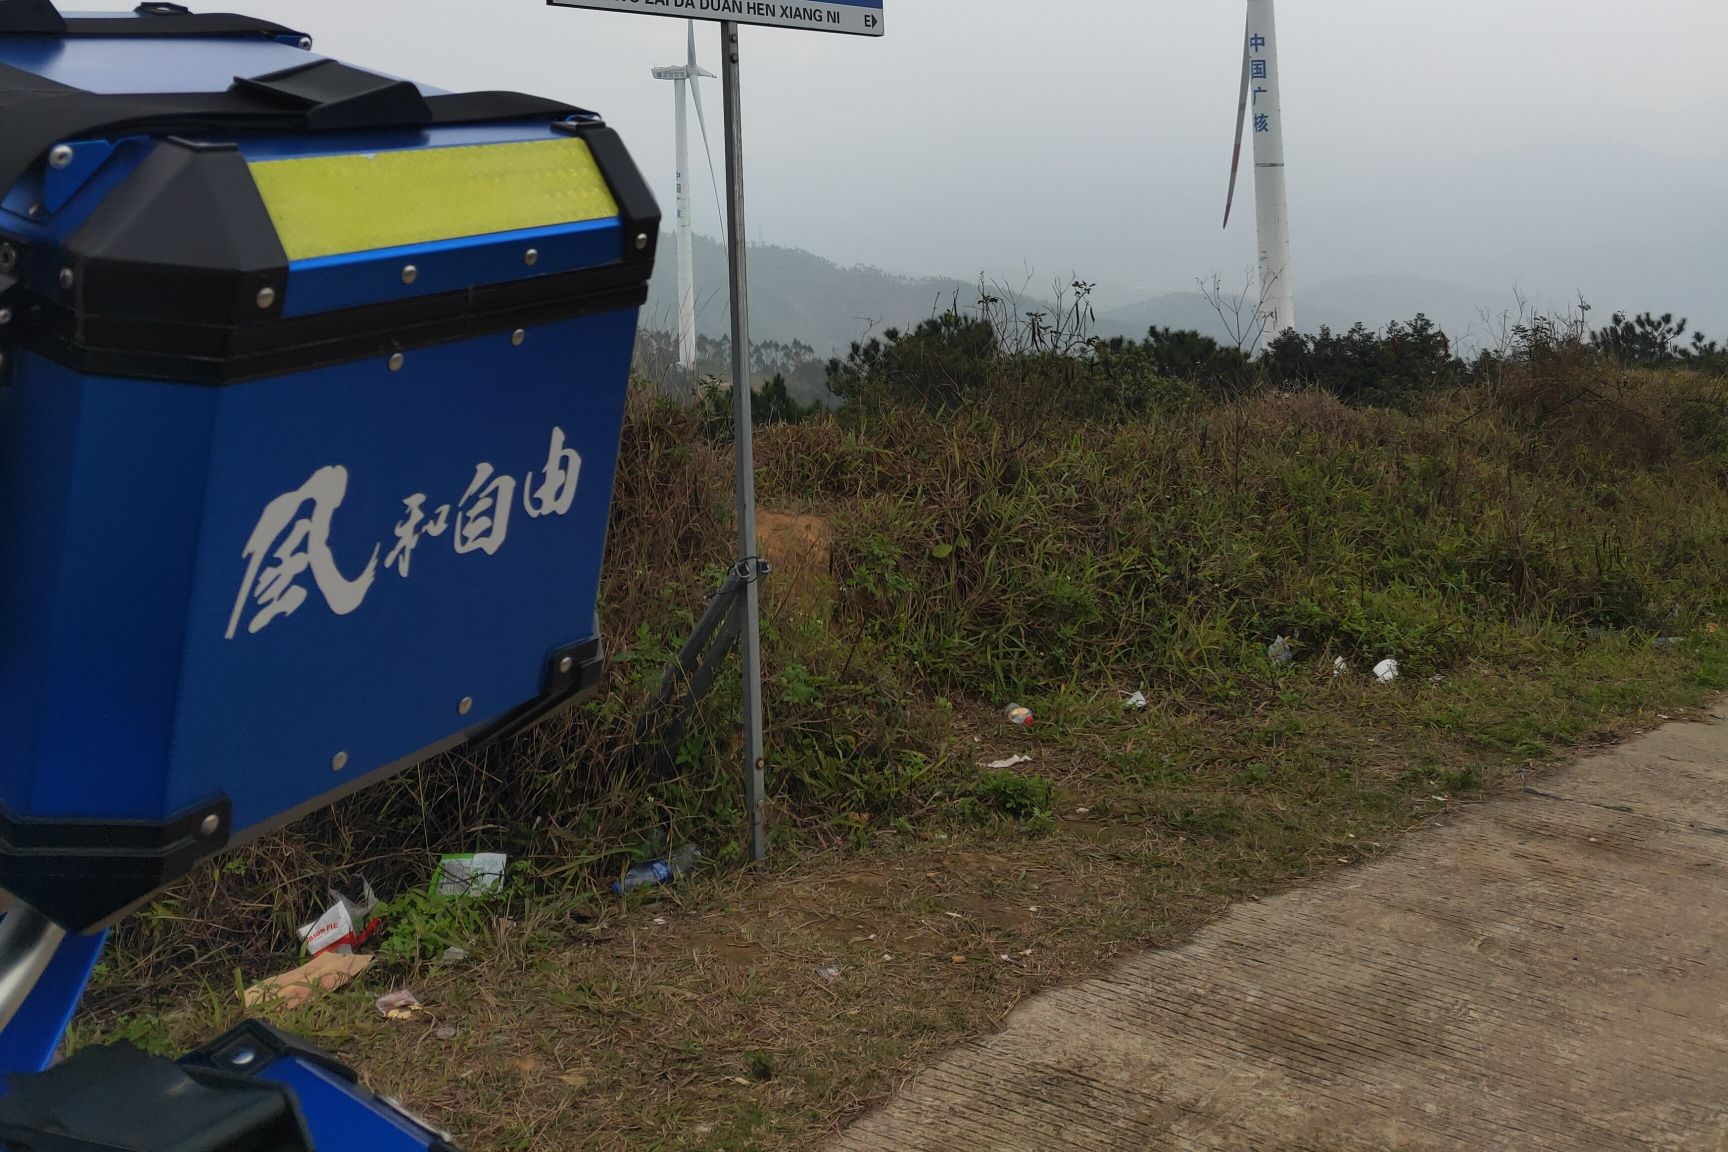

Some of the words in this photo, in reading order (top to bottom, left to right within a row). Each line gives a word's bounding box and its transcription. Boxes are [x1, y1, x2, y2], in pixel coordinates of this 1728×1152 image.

[747, 2, 776, 18] HEN
[780, 5, 823, 23] XIANG
[827, 11, 840, 24] NI
[864, 14, 872, 28] E
[1249, 32, 1269, 133] 中国广核
